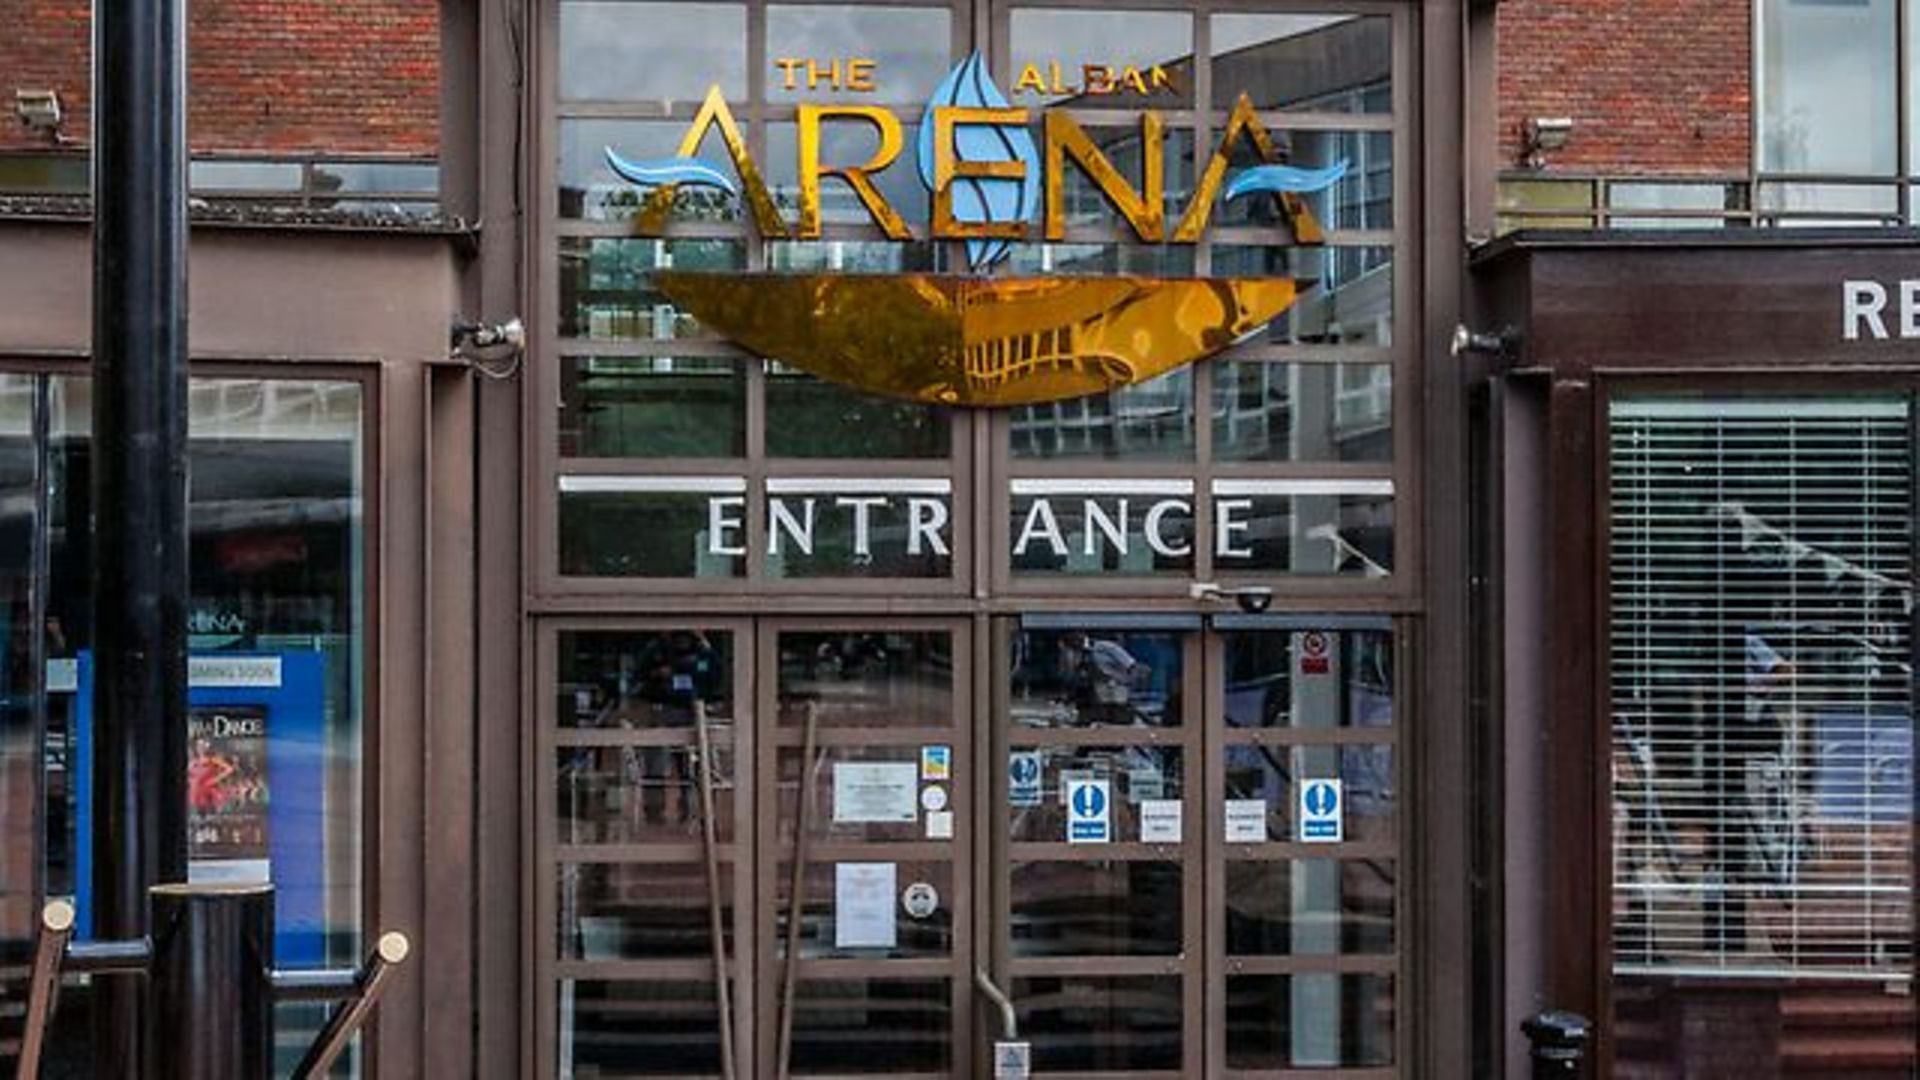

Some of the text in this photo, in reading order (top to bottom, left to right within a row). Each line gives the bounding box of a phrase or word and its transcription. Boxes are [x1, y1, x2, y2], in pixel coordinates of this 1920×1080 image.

[776, 57, 1182, 97] THE ALBAN
[606, 84, 1348, 243] ARENA
[1842, 279, 1920, 339] RE
[708, 496, 1254, 558] ENTRANCE
